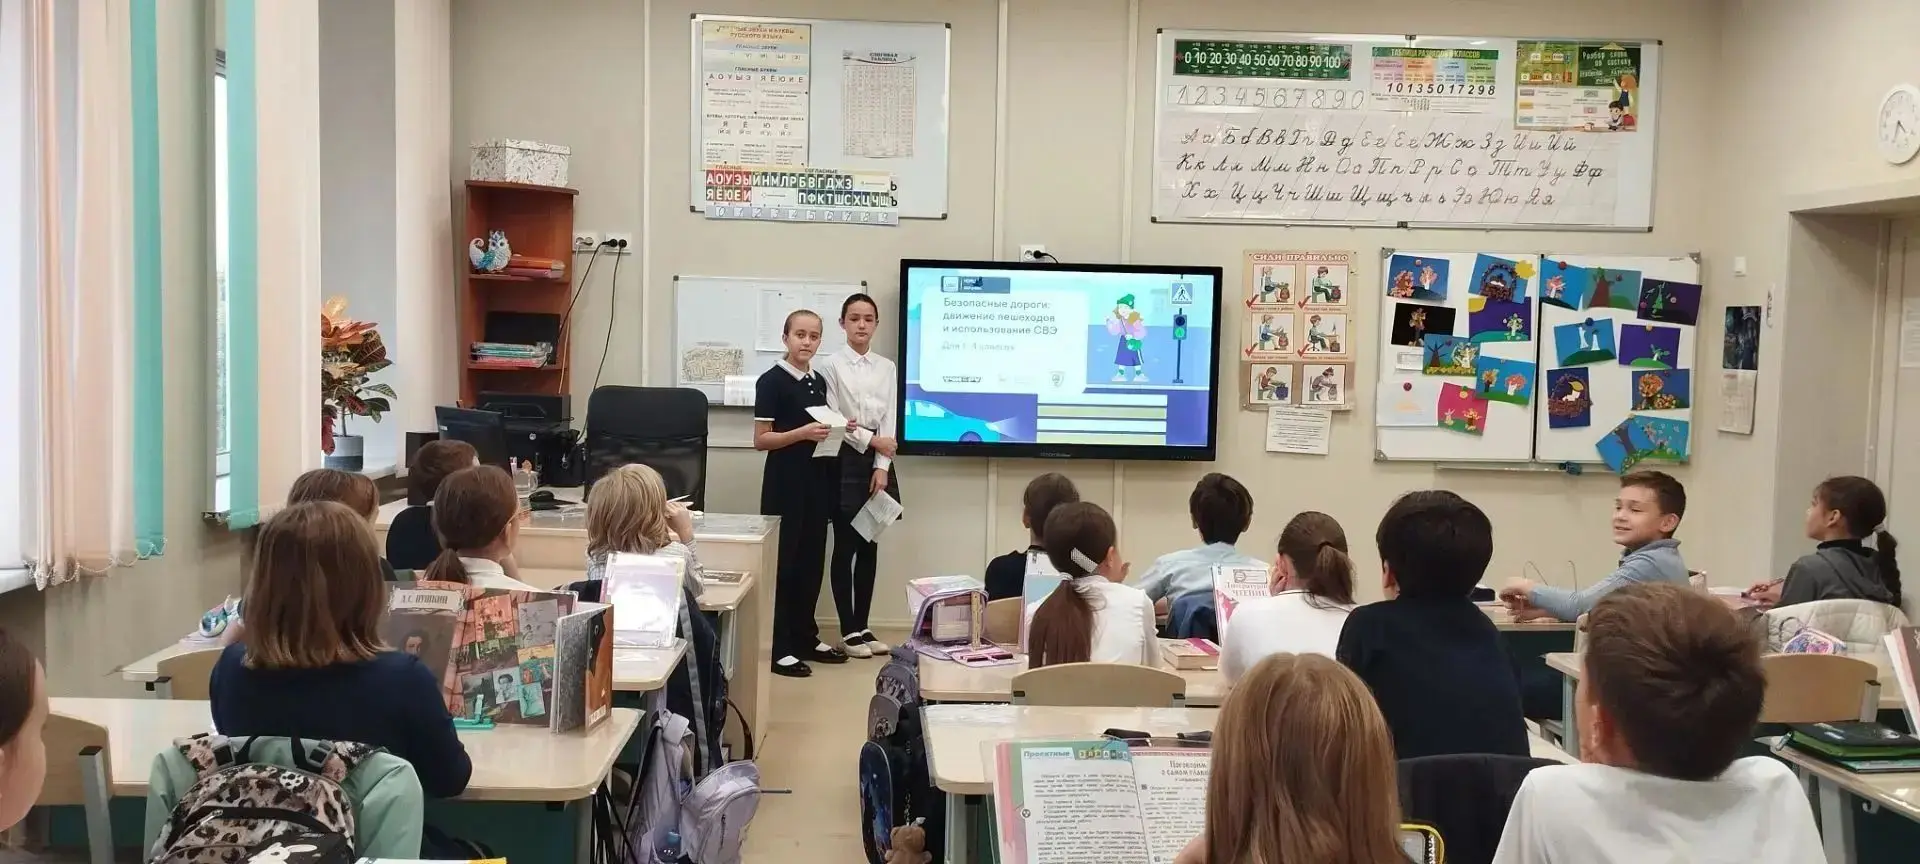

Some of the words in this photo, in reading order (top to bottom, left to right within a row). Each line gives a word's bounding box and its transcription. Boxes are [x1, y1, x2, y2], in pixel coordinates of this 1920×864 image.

[1185, 52, 1192, 64] 0
[1194, 52, 1206, 64] 10
[1210, 52, 1222, 64] 20
[1224, 53, 1236, 64] 30
[1239, 54, 1251, 66] 40
[1254, 54, 1266, 66] 50
[1268, 54, 1280, 66] 60
[1283, 55, 1294, 67] 70
[1296, 55, 1308, 68] 80
[1310, 56, 1322, 68] 90
[1324, 56, 1340, 68] 100
[1254, 253, 1282, 261] СИДИ
[1286, 253, 1349, 262] ПРАВИЛЬНО
[944, 298, 1008, 308] Безопасные
[1010, 300, 1050, 310] дороги:
[943, 312, 996, 321] движение
[998, 314, 1055, 324] пешеходов
[952, 326, 1031, 335] использование
[1033, 326, 1058, 335] СВЭ
[1023, 750, 1070, 758] Проектные
